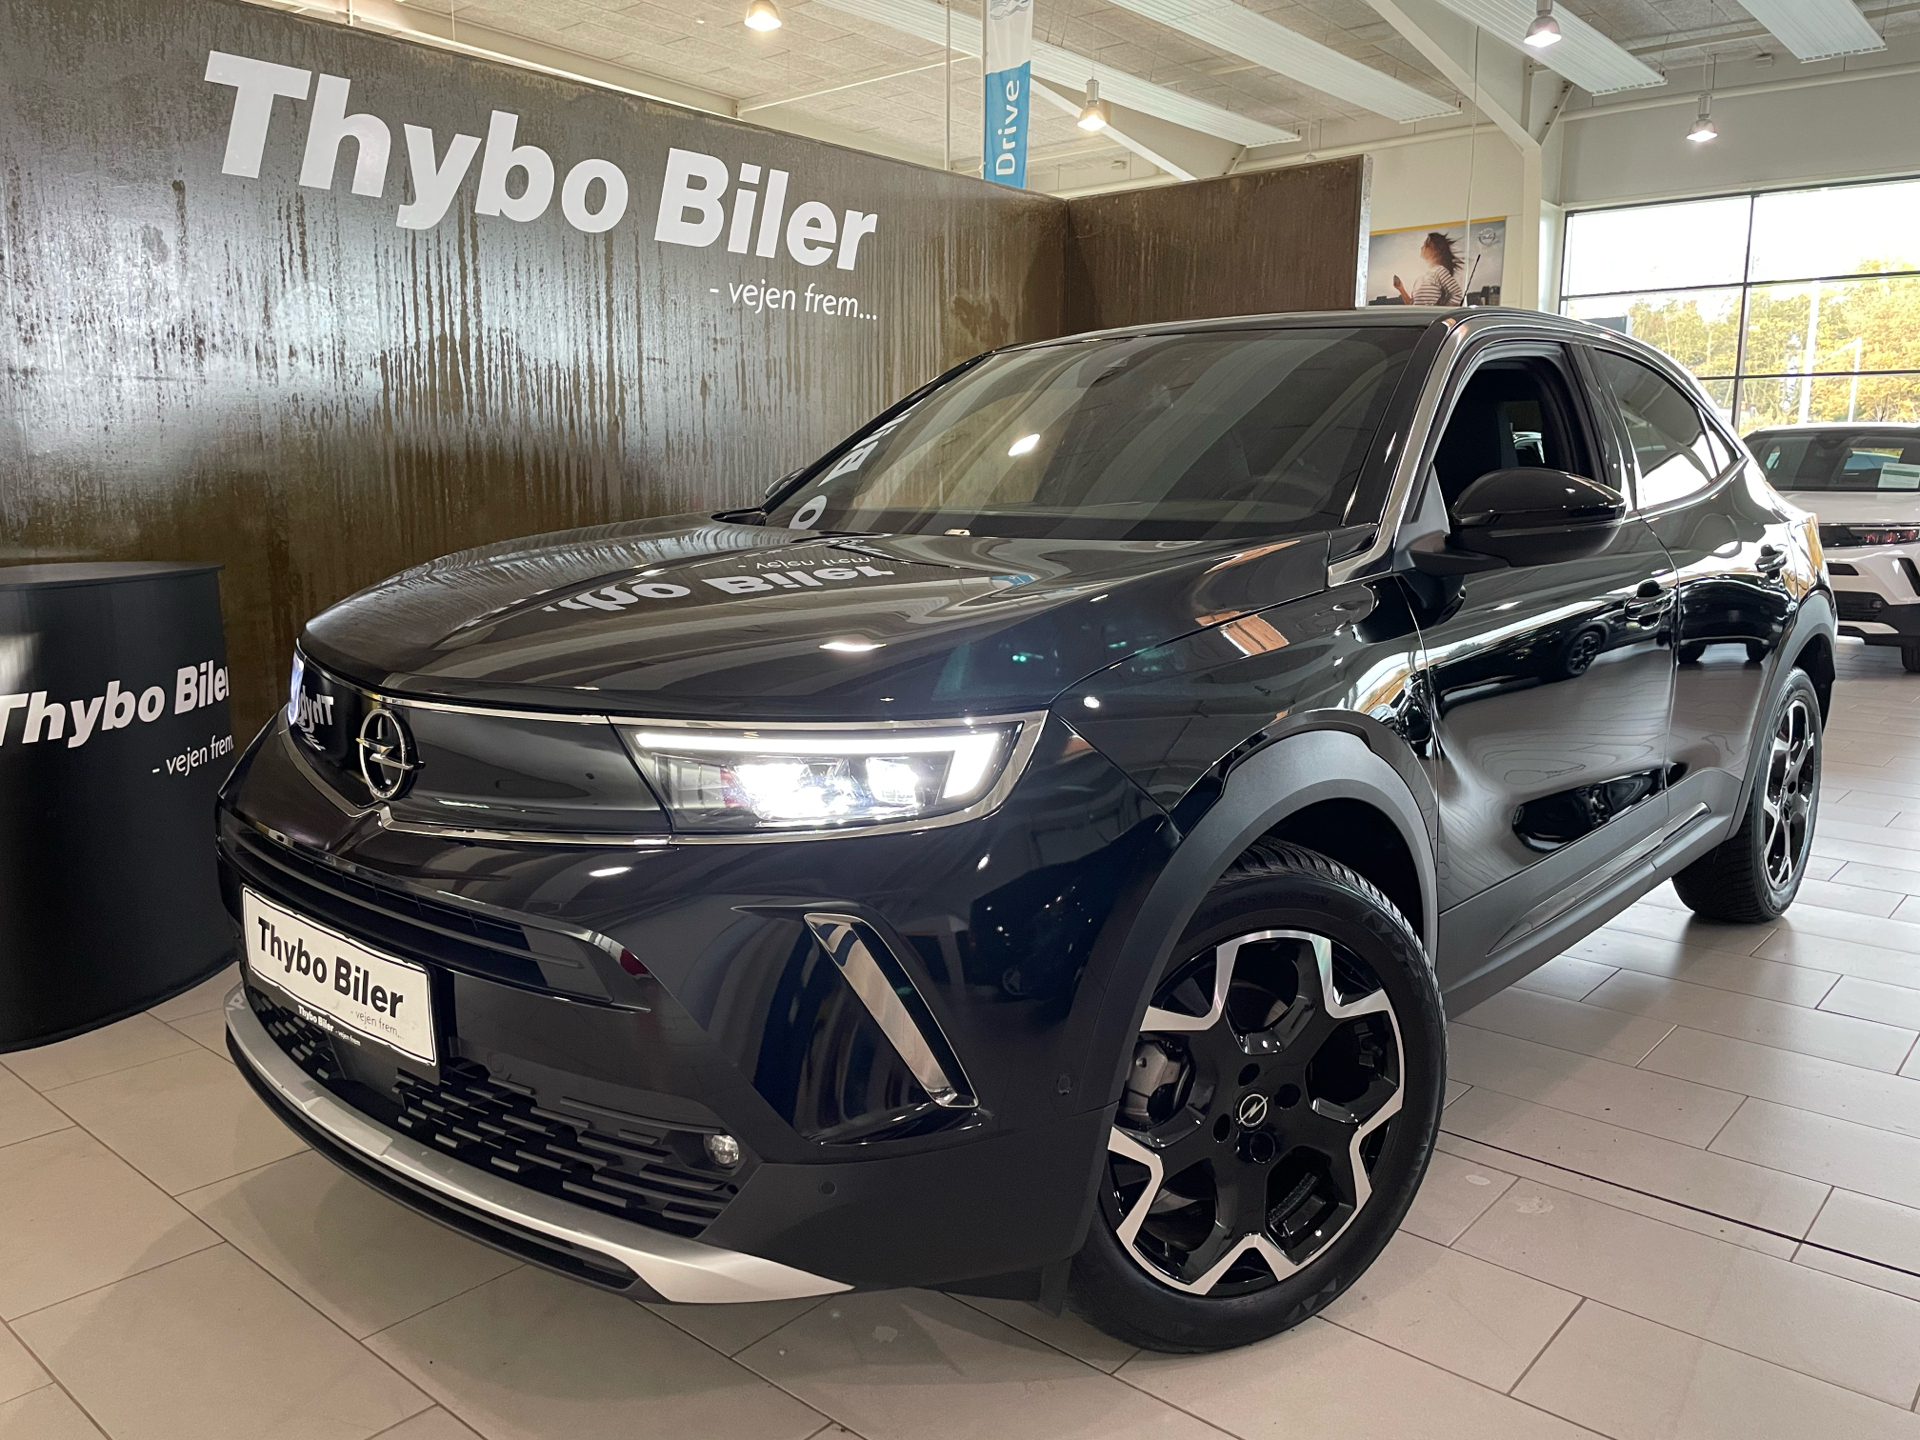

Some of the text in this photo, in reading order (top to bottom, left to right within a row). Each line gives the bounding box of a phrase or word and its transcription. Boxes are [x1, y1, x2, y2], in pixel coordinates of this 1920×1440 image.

[996, 79, 1020, 176] Drive
[204, 50, 878, 271] Thybo Biler
[728, 278, 796, 314] vejen
[804, 283, 877, 320] frem...
[0, 680, 166, 749] Thybo
[166, 746, 208, 776] vejen
[258, 916, 404, 1018] Thybo Biler
[298, 1004, 318, 1024] Thybo
[317, 1015, 334, 1032] Biler
[355, 1010, 377, 1027] vejen
